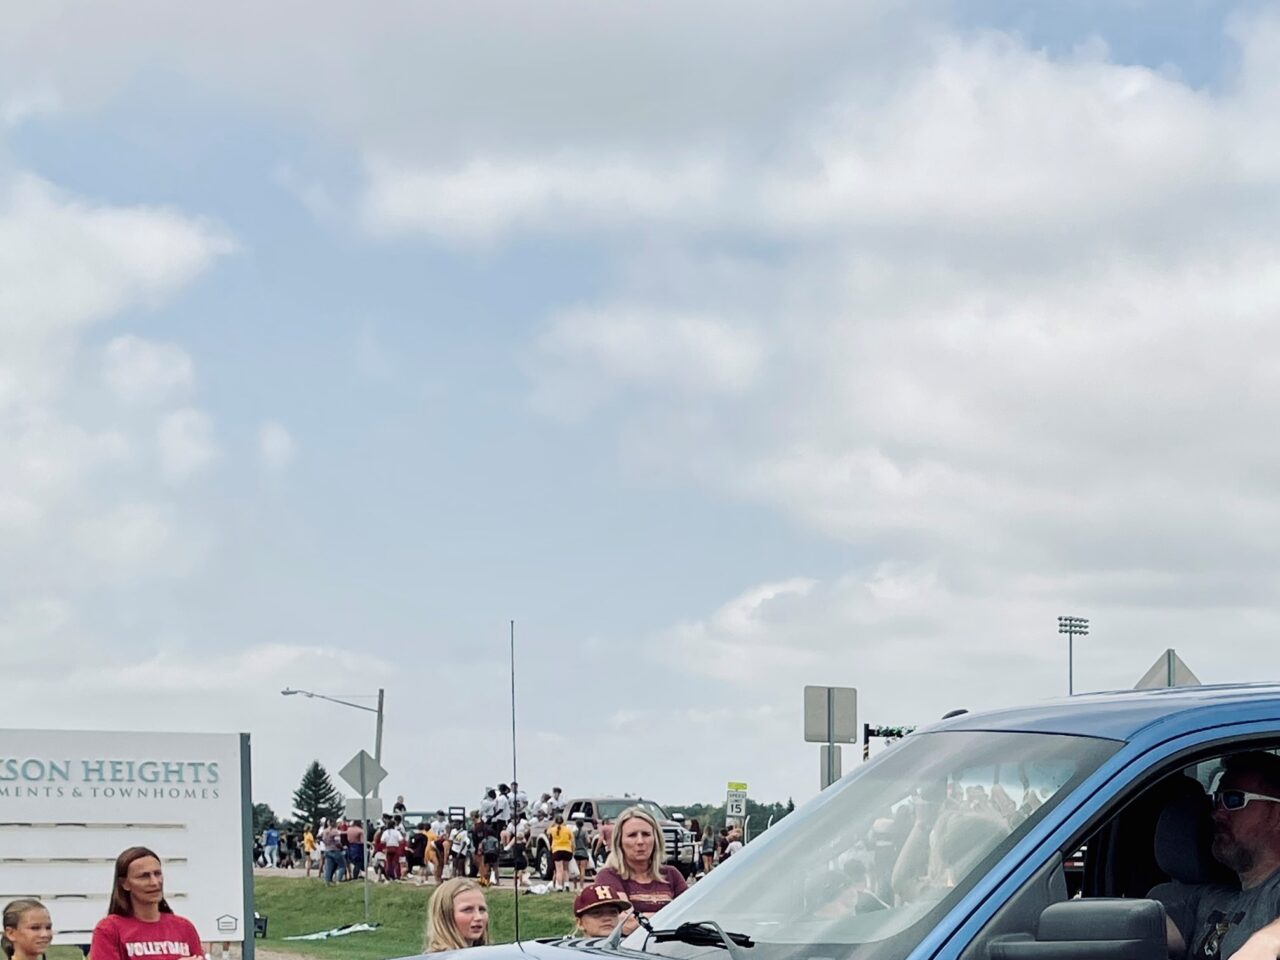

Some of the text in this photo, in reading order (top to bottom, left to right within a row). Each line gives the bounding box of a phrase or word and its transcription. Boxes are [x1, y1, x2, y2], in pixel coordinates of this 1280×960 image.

[0, 758, 220, 784] SON HEIGHTS
[72, 787, 83, 798] &
[90, 786, 220, 800] TOWNHOMES
[730, 803, 742, 814] 15
[594, 885, 613, 900] H
